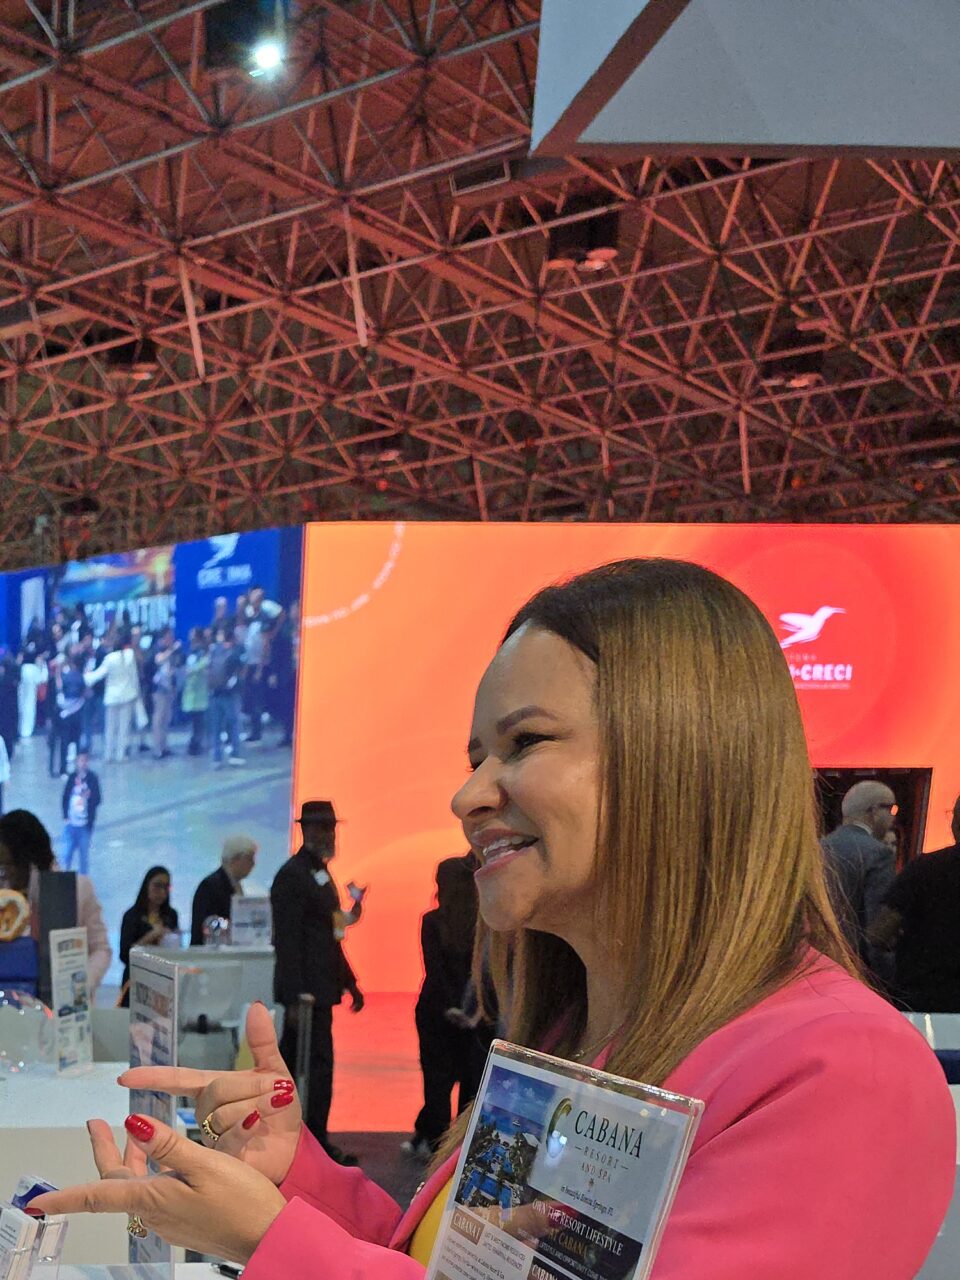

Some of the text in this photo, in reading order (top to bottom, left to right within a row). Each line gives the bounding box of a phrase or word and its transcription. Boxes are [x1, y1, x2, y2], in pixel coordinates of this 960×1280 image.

[575, 1110, 644, 1158] CABANA
[583, 1147, 620, 1169] RESORT
[581, 1162, 611, 1183] AND SPA
[453, 1213, 477, 1239] CABANA
[532, 1198, 546, 1215] OWN
[548, 1204, 561, 1221] THE
[560, 1211, 585, 1237] RESORT
[586, 1225, 624, 1257] LIFESTYLE
